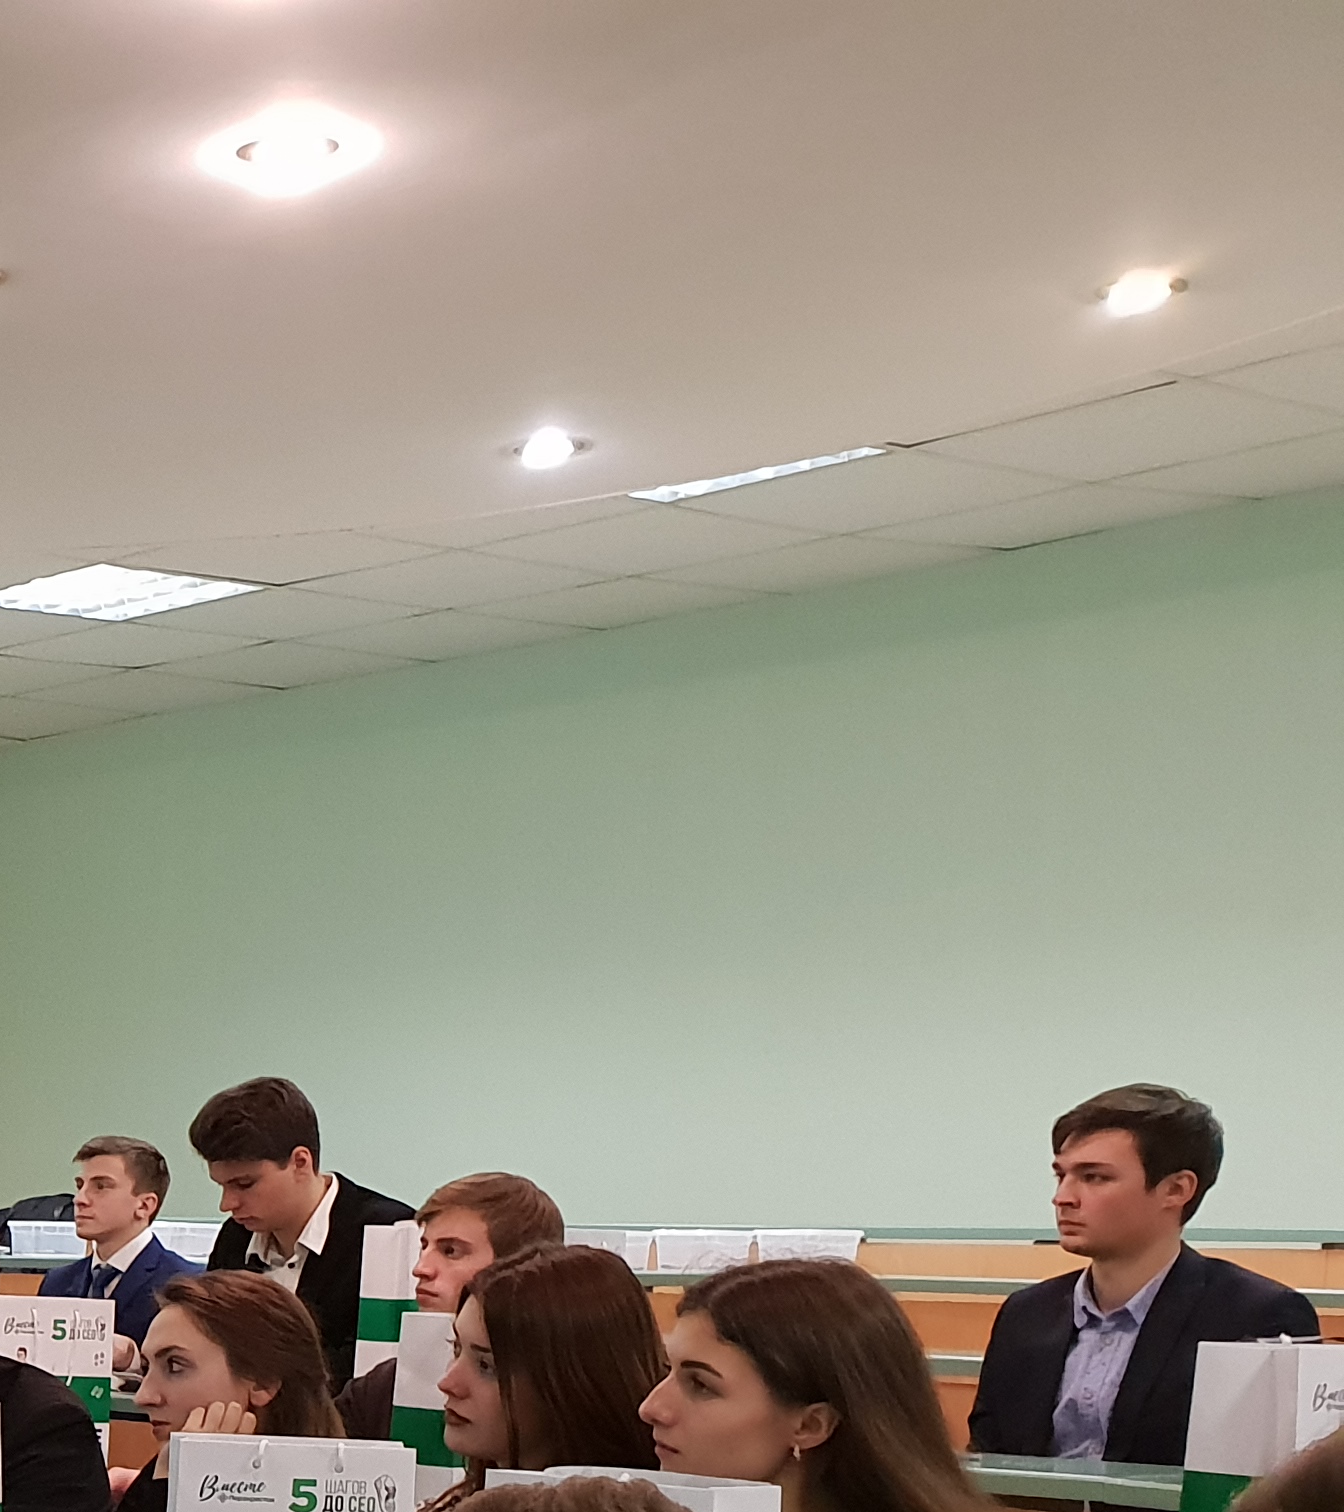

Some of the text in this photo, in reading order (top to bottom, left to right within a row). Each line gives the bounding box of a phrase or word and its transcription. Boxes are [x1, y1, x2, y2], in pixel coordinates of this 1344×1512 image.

[52, 1319, 66, 1340] 5
[199, 1475, 266, 1502] Вместе
[325, 1479, 367, 1494] ШАГОВ
